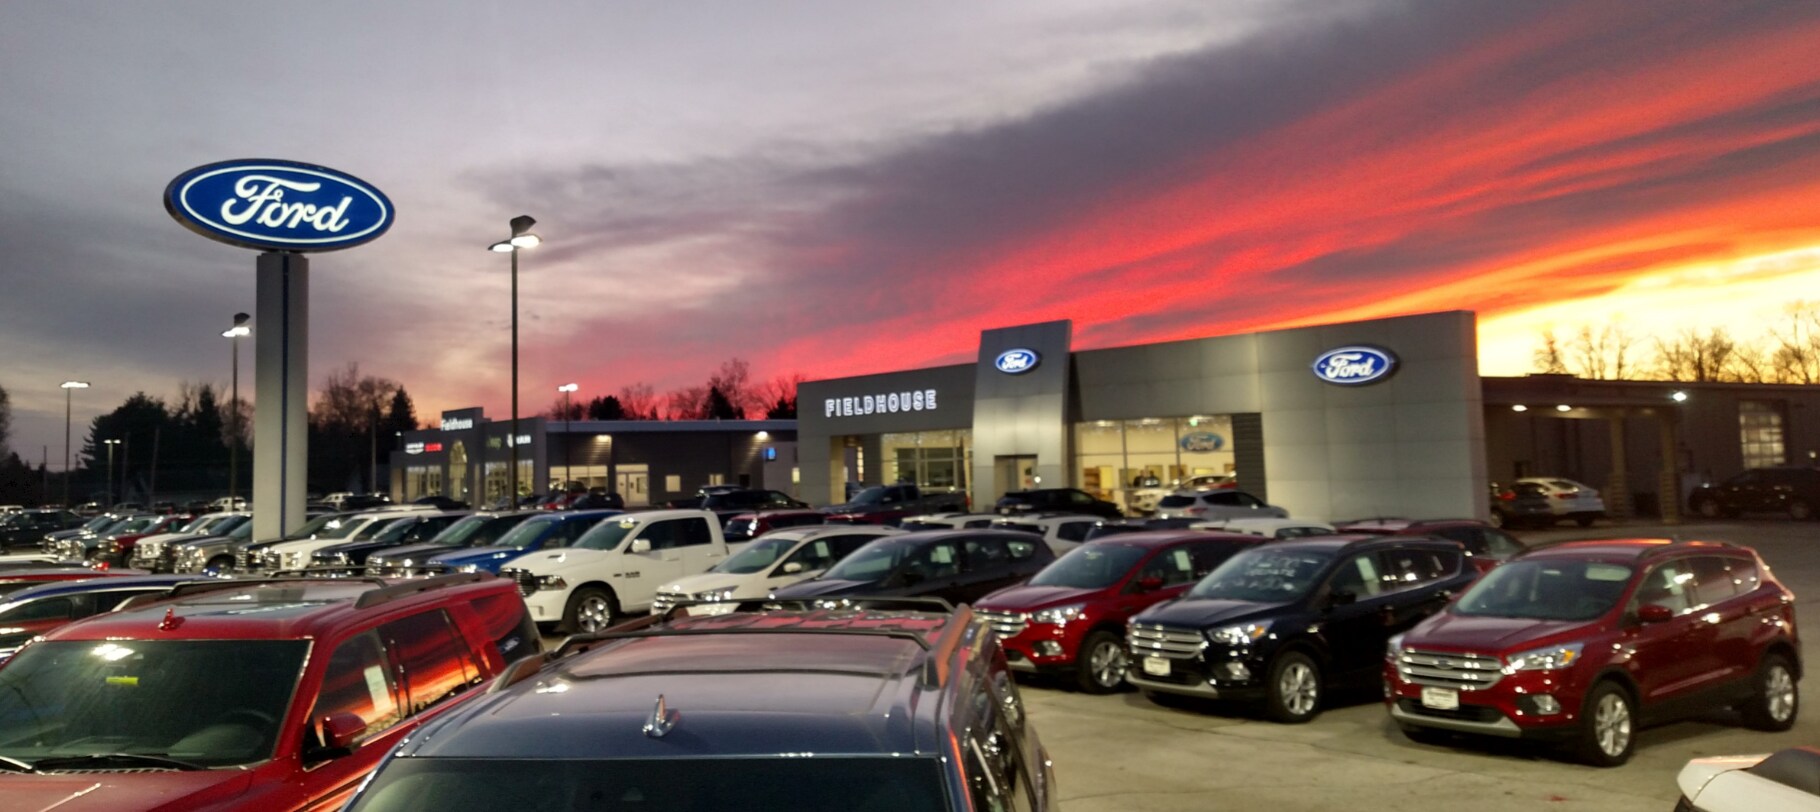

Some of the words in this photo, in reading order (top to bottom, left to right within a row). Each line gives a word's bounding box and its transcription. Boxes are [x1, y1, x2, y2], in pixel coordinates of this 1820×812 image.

[221, 174, 353, 233] Ford
[1001, 353, 1028, 371] Ford
[1325, 353, 1375, 379] Ford
[824, 389, 938, 418] FIELDHOUSE
